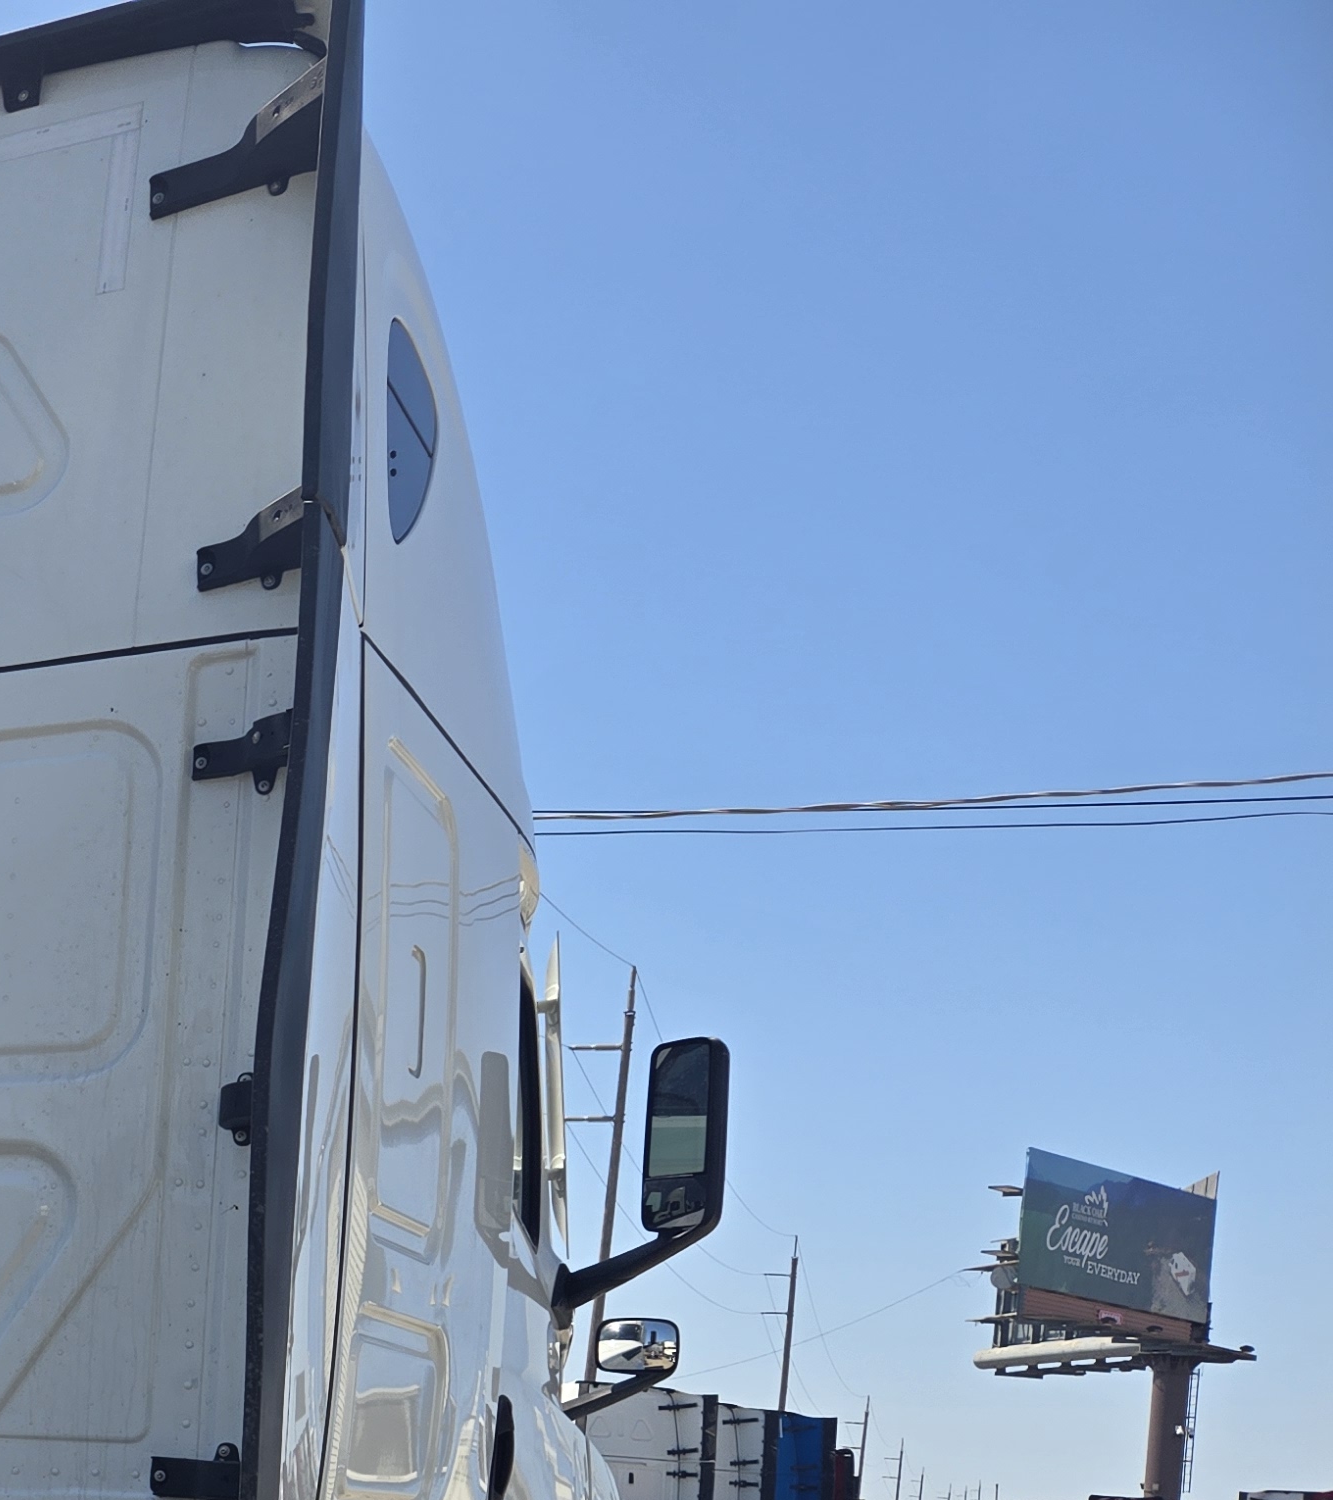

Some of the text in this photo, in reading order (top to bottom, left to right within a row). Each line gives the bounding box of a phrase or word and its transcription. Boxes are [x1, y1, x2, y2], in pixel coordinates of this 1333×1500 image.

[1073, 1202, 1091, 1215] BLACK
[1047, 1205, 1108, 1268] Escape
[1087, 1261, 1140, 1285] EVERYDAY
